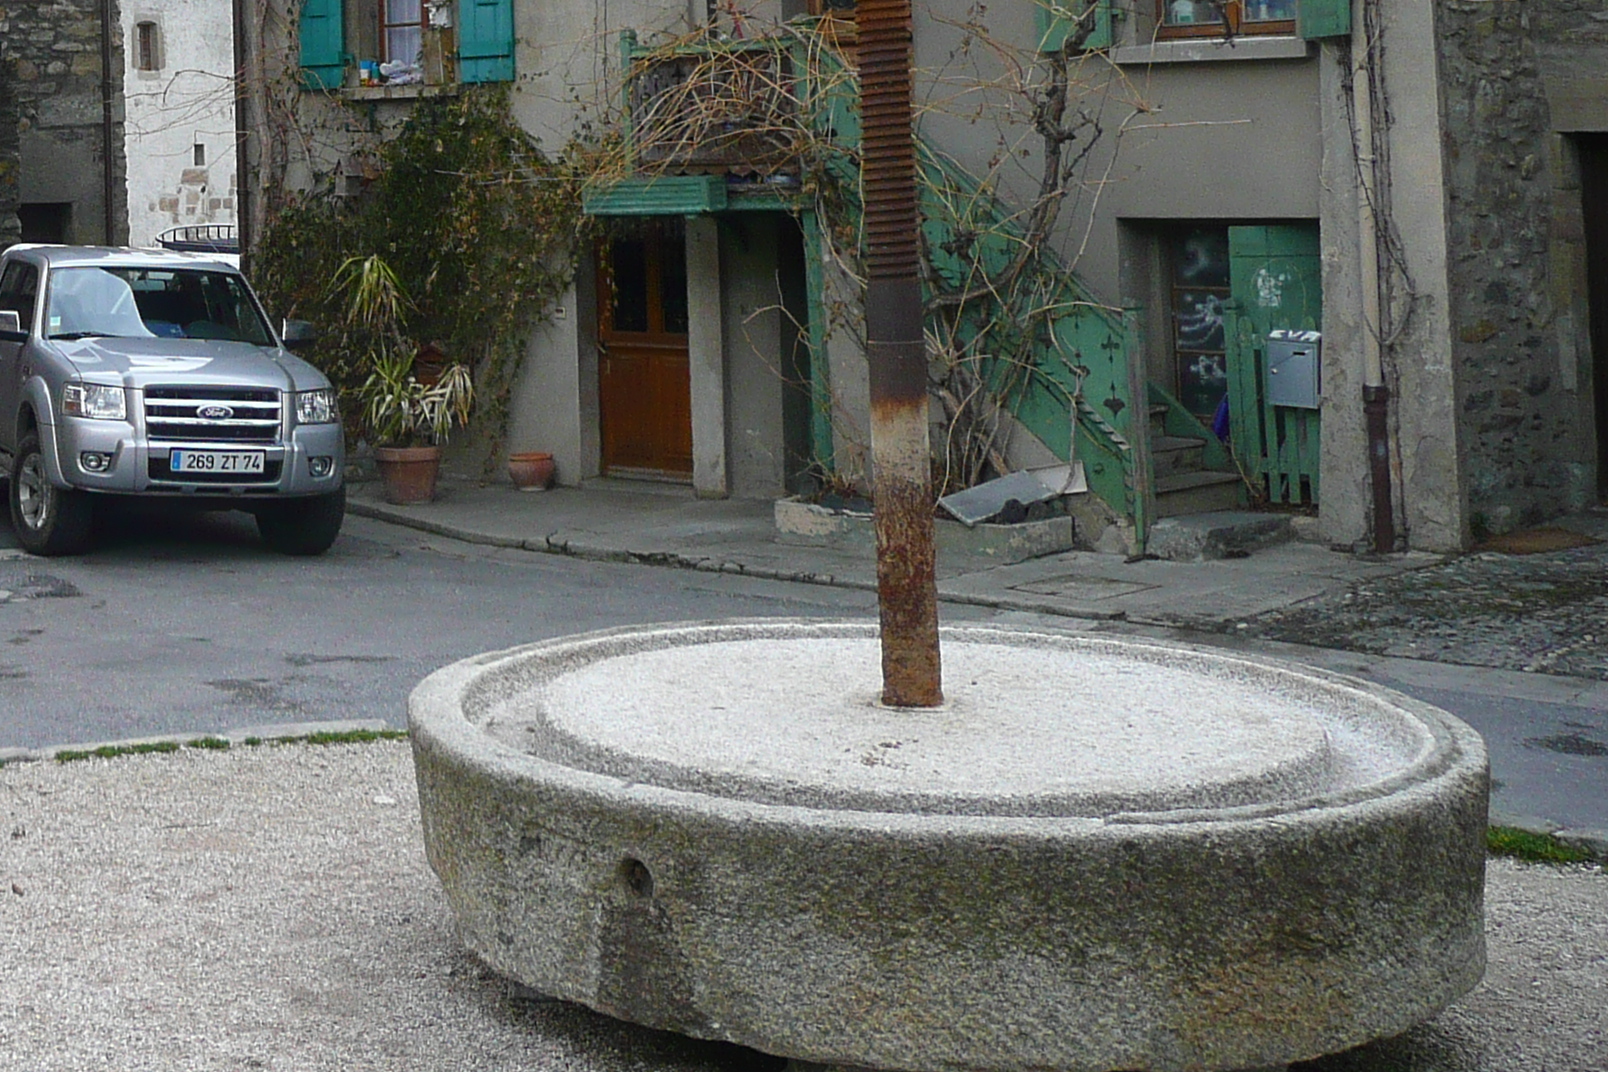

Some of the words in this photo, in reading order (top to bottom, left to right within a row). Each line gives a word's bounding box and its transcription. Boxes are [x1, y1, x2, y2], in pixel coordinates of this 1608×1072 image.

[204, 407, 226, 417] Ford
[186, 454, 215, 470] 269
[221, 455, 240, 471] ZT
[243, 455, 260, 471] 74
